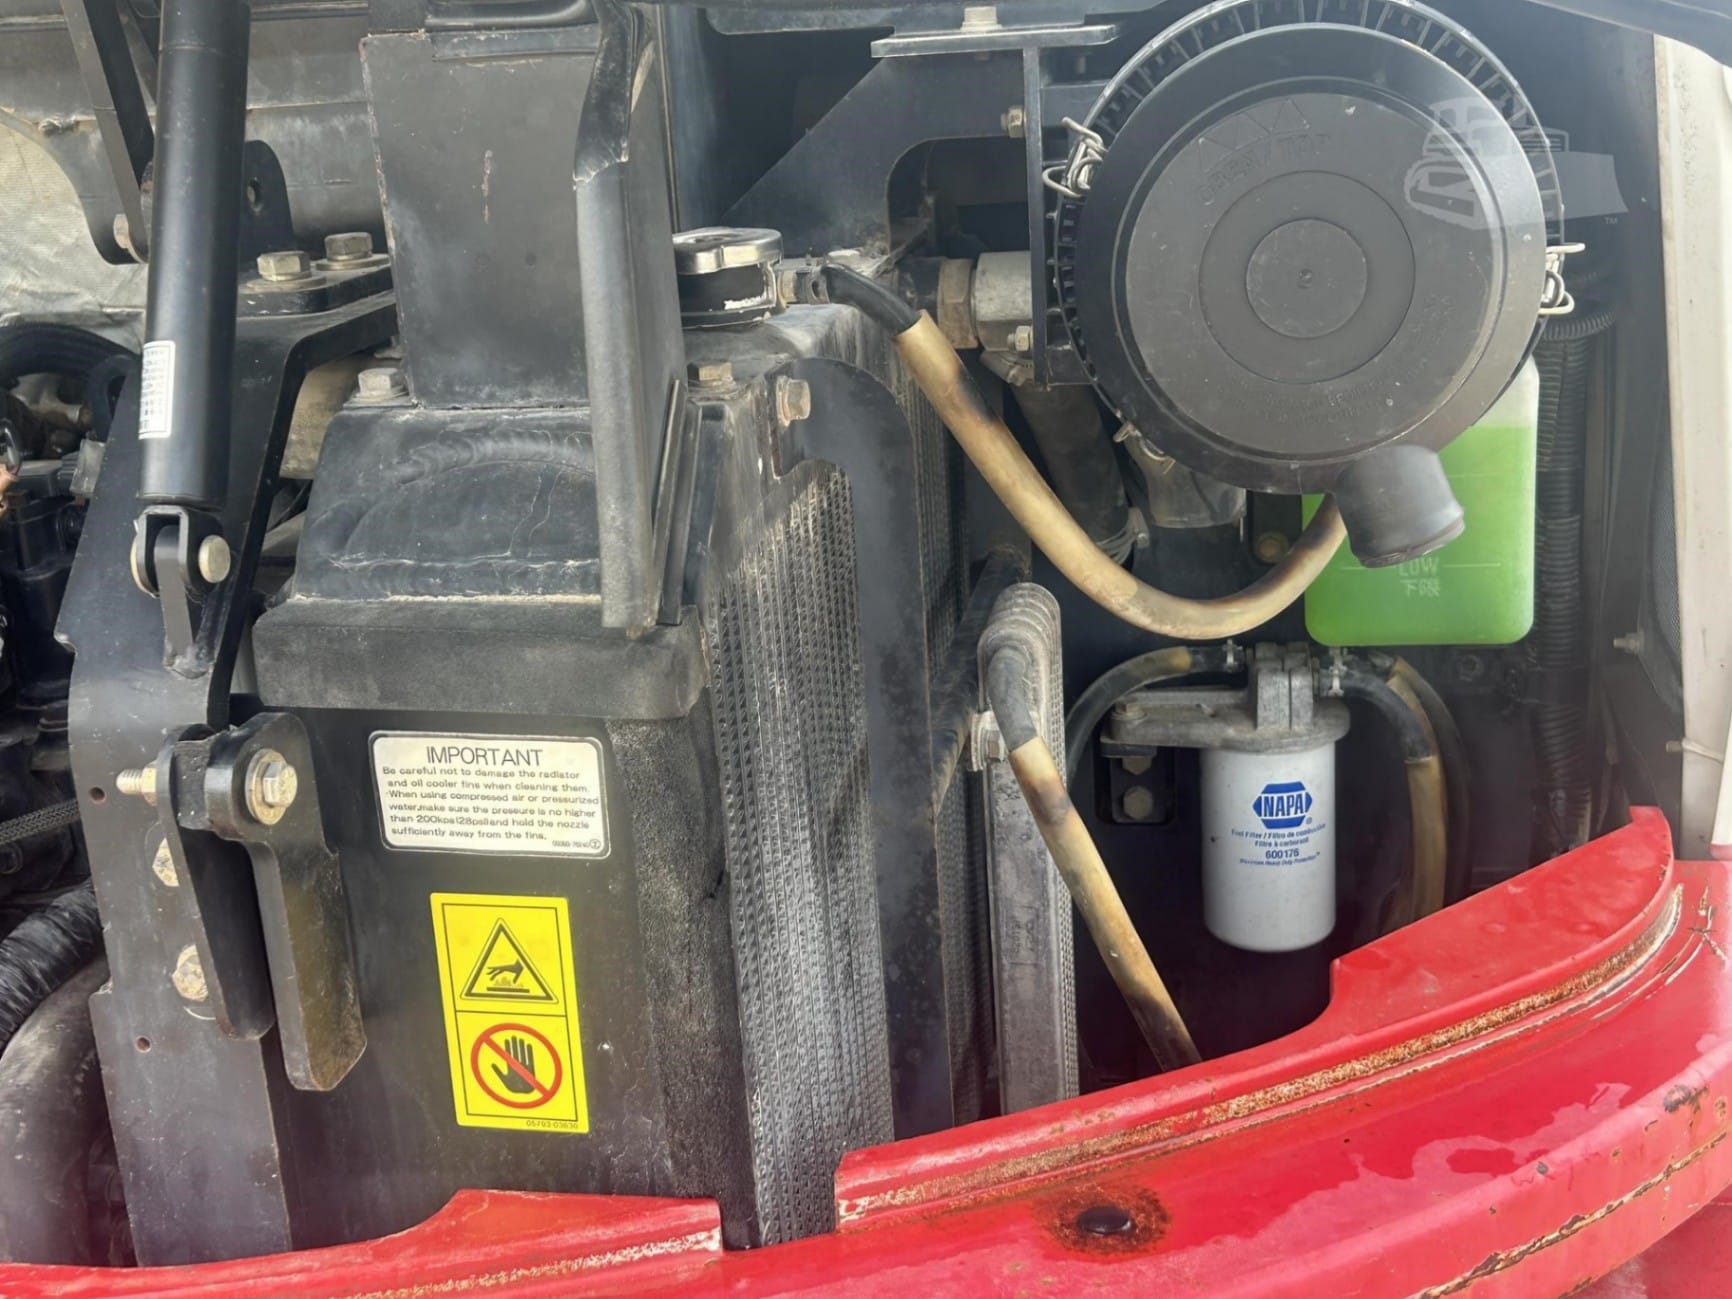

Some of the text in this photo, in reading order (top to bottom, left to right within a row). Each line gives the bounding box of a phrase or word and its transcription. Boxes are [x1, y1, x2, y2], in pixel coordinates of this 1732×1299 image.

[1399, 556, 1440, 576] LOW
[426, 746, 543, 766] IMPORTANT
[382, 766, 397, 774] Be
[399, 766, 437, 775] careful
[474, 769, 515, 778] damage
[539, 770, 580, 779] radiator
[387, 779, 408, 787] and
[411, 779, 424, 787] oil
[426, 780, 458, 788] cooler
[483, 782, 512, 790] when
[515, 783, 559, 792] cleaning
[420, 791, 447, 800] using
[450, 793, 509, 801] compressed
[511, 794, 525, 802] air
[542, 796, 600, 805] pressurized
[1264, 793, 1304, 817] NAPA
[472, 806, 489, 814] the
[491, 807, 535, 815] pressure
[564, 809, 596, 818] higher
[390, 814, 414, 822] than
[511, 818, 534, 827] hold
[537, 819, 554, 827] the
[557, 821, 590, 829] nozzle
[391, 826, 547, 840] sufficiently away from the fins.
[1245, 830, 1262, 839] Filter
